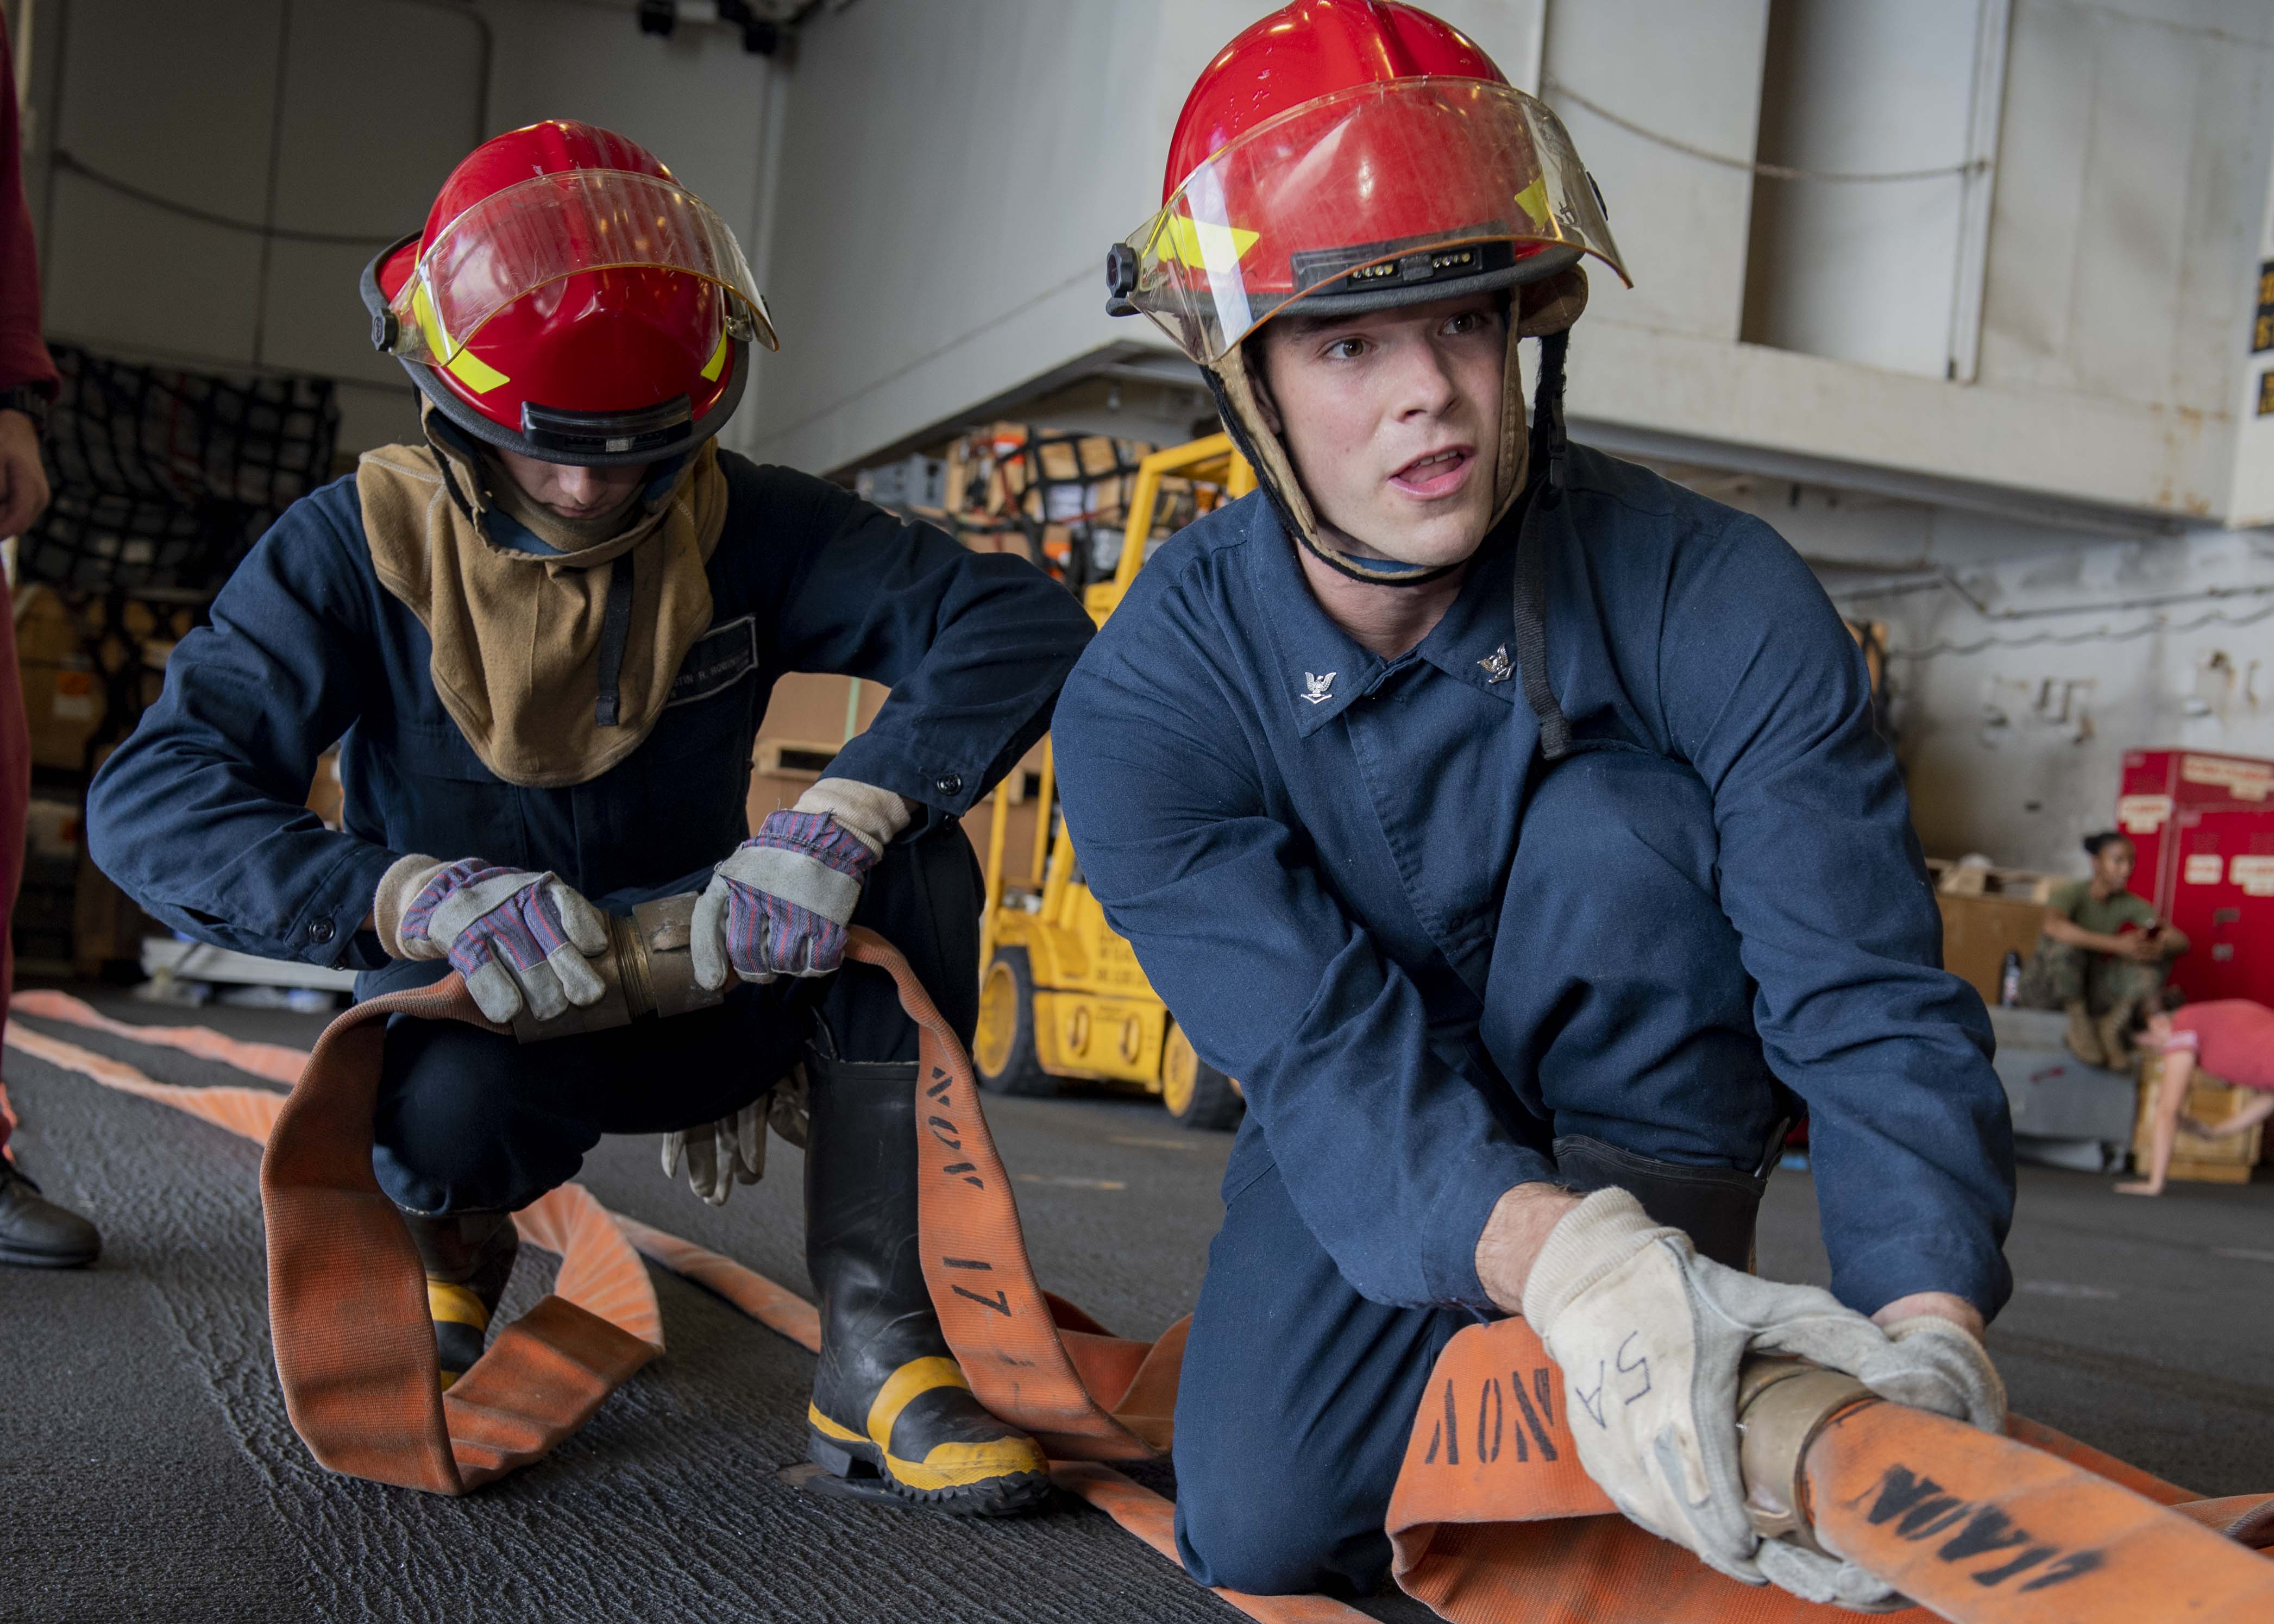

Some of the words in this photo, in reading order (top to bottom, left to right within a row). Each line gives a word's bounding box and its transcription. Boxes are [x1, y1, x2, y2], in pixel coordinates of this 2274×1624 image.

[927, 1066, 984, 1190] NOV
[943, 1257, 1011, 1317] 17
[1424, 1368, 1557, 1465] NOV
[1576, 1330, 1651, 1430] 5A
